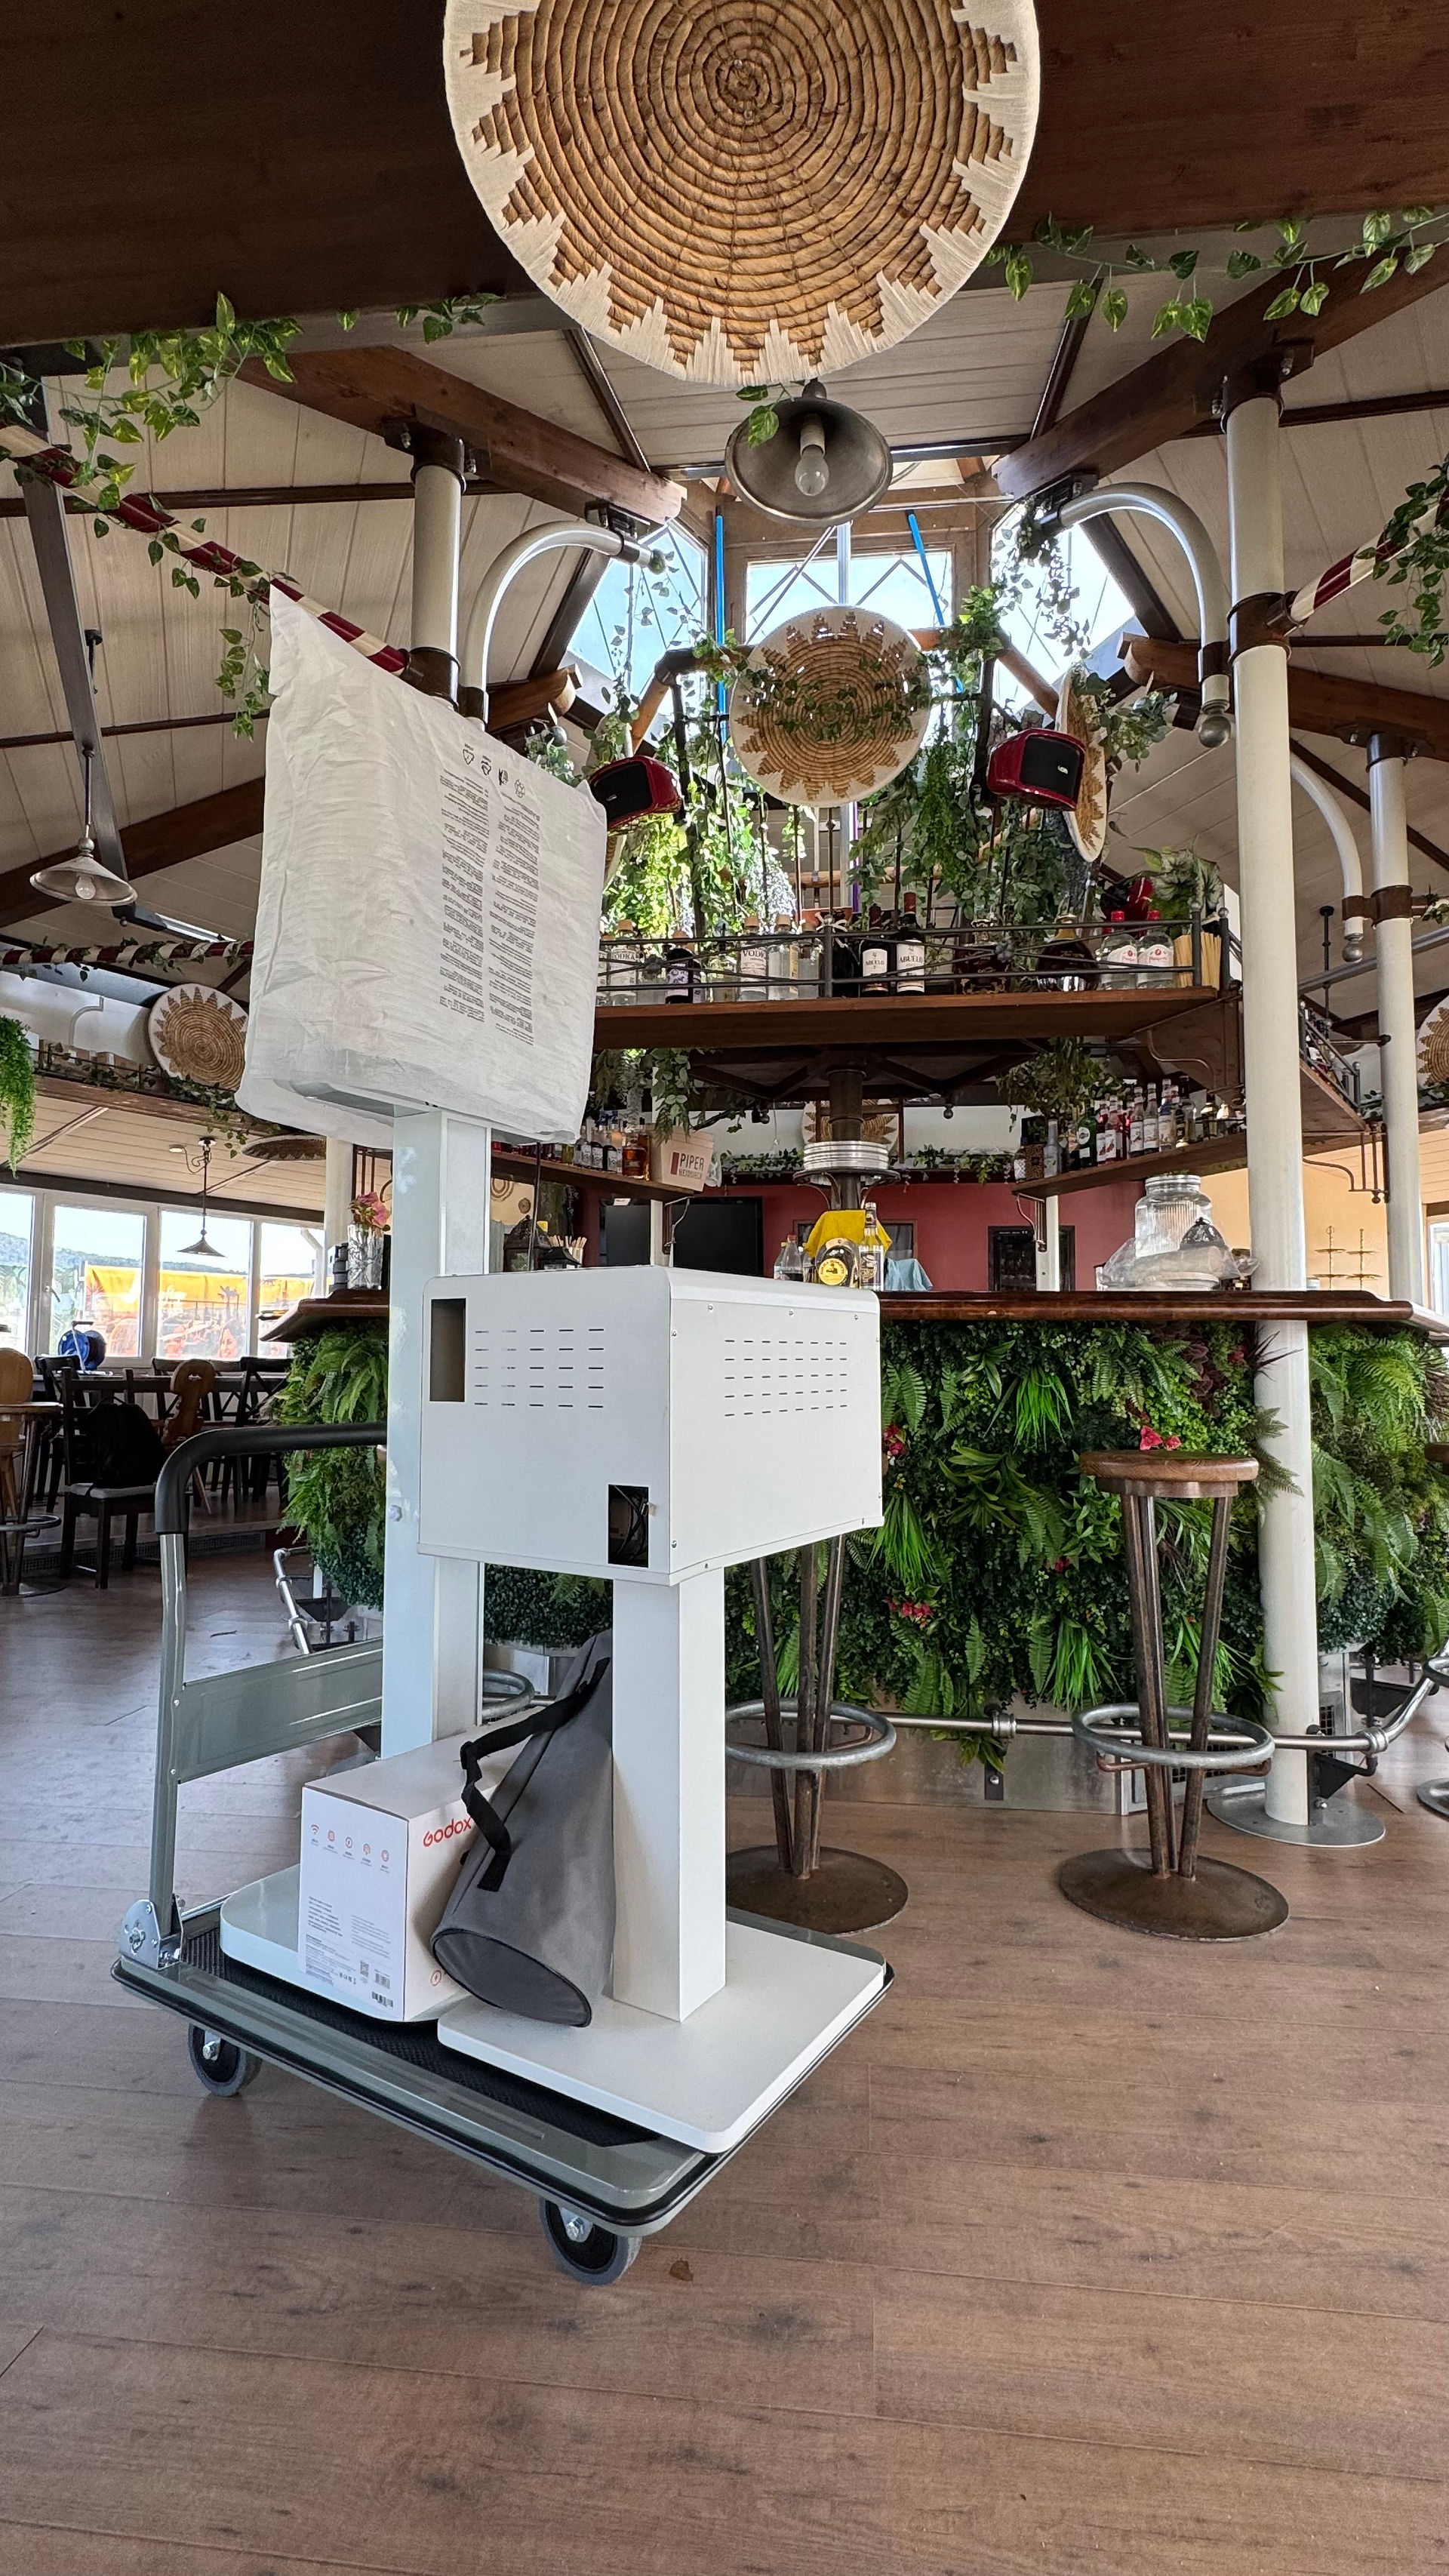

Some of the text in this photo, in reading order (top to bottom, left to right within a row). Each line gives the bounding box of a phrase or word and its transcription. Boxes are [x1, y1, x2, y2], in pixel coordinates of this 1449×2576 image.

[899, 955, 923, 964] ABUELO
[680, 1153, 705, 1171] PIPER
[423, 1817, 472, 1847] Godox
